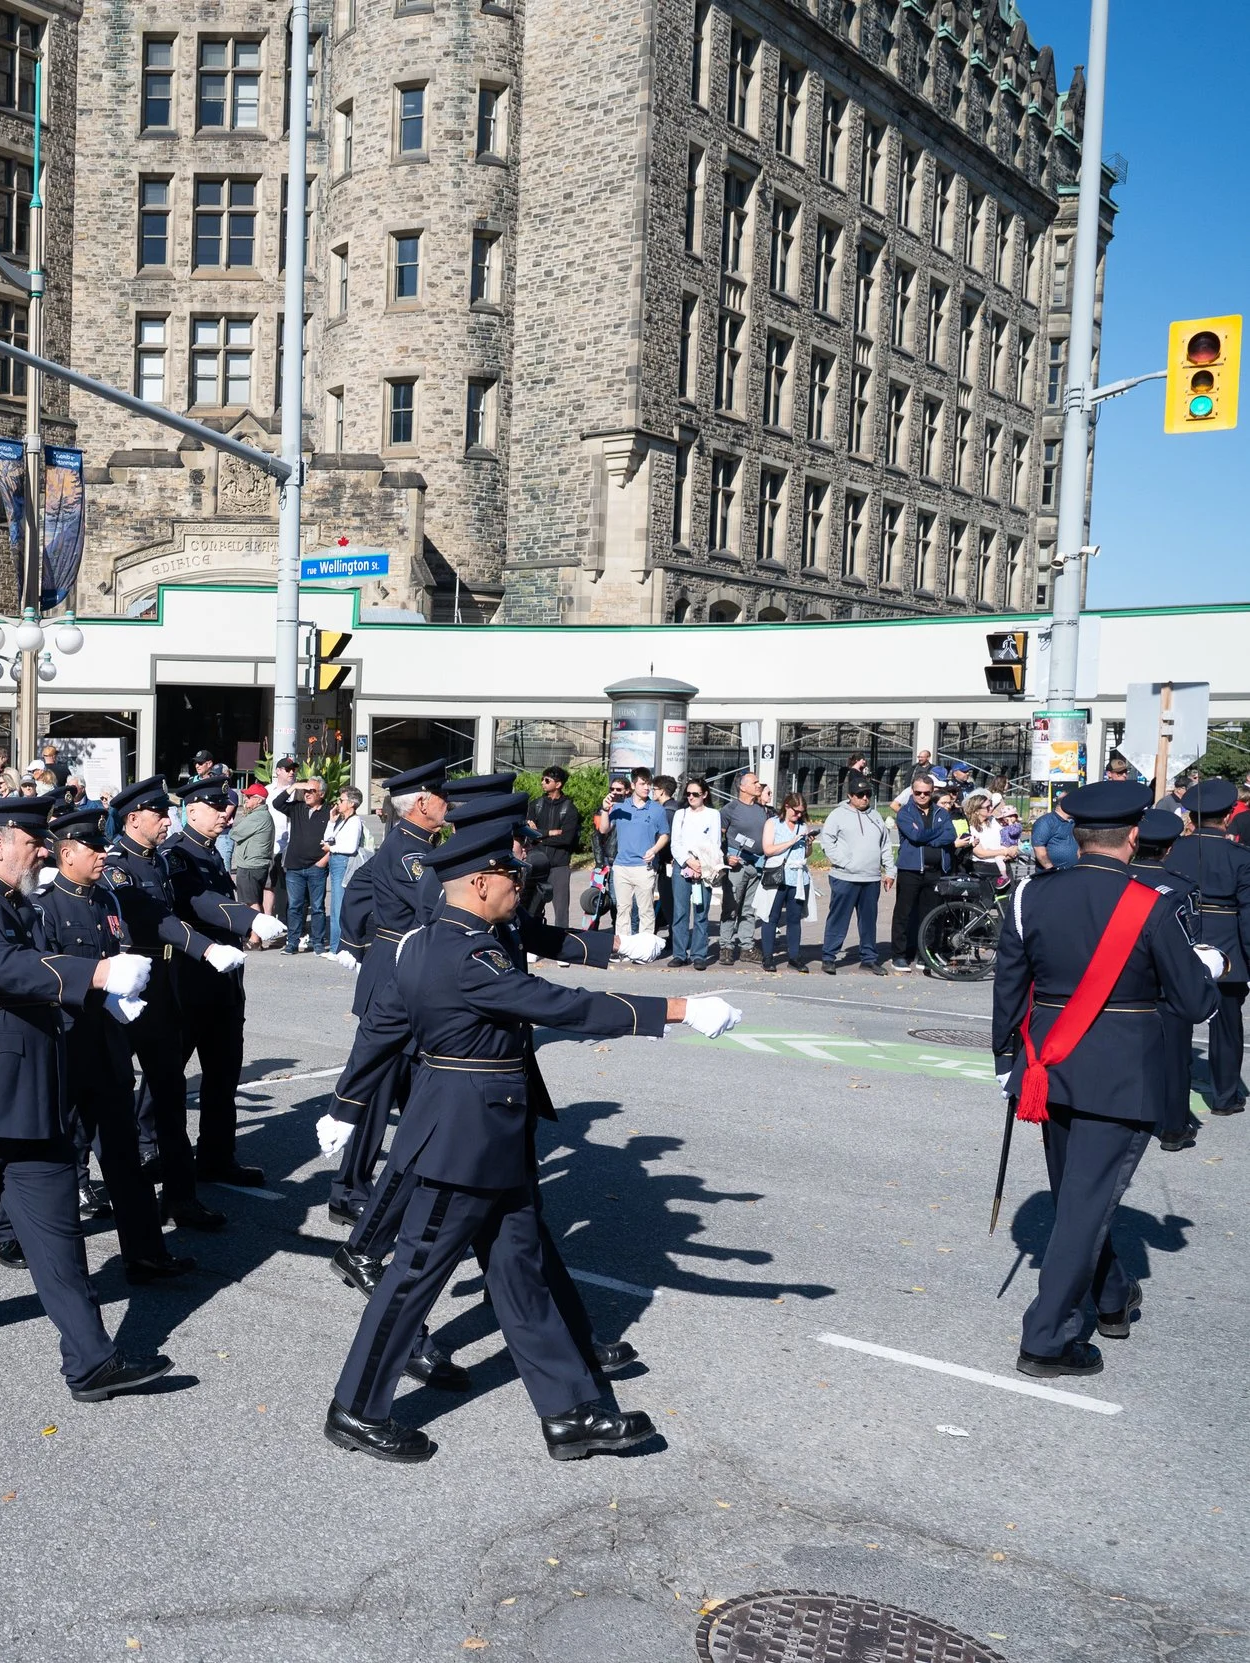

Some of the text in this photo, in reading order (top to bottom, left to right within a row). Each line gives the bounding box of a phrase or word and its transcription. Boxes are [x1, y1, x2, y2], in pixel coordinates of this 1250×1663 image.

[190, 540, 279, 553] CONFEDERAT
[151, 555, 211, 575] EDIFICE
[307, 559, 380, 576] rue Wellington St.
